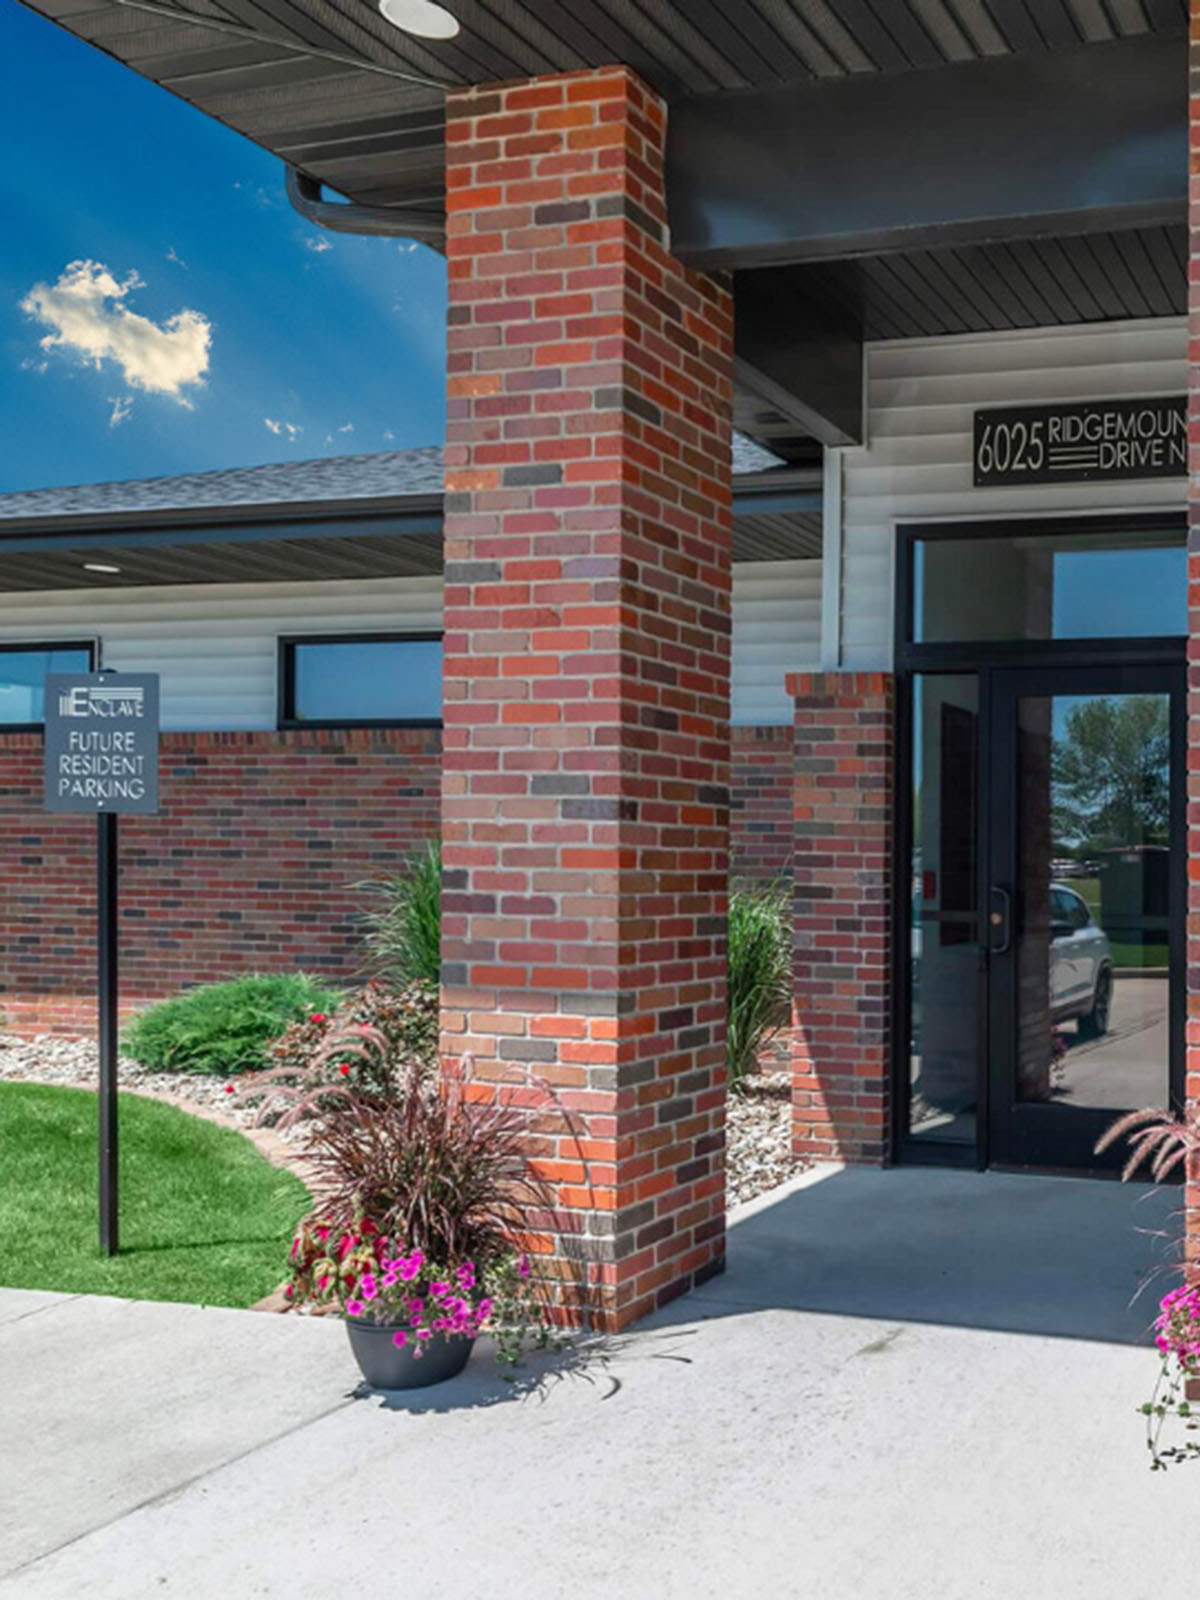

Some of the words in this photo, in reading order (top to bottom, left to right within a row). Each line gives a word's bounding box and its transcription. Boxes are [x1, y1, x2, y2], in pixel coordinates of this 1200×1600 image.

[977, 421, 1044, 473] 6025
[1100, 439, 1164, 469] DRIVE
[70, 731, 135, 752] FUTURE
[59, 755, 144, 775] RESIDENT
[59, 778, 145, 799] PARKING
